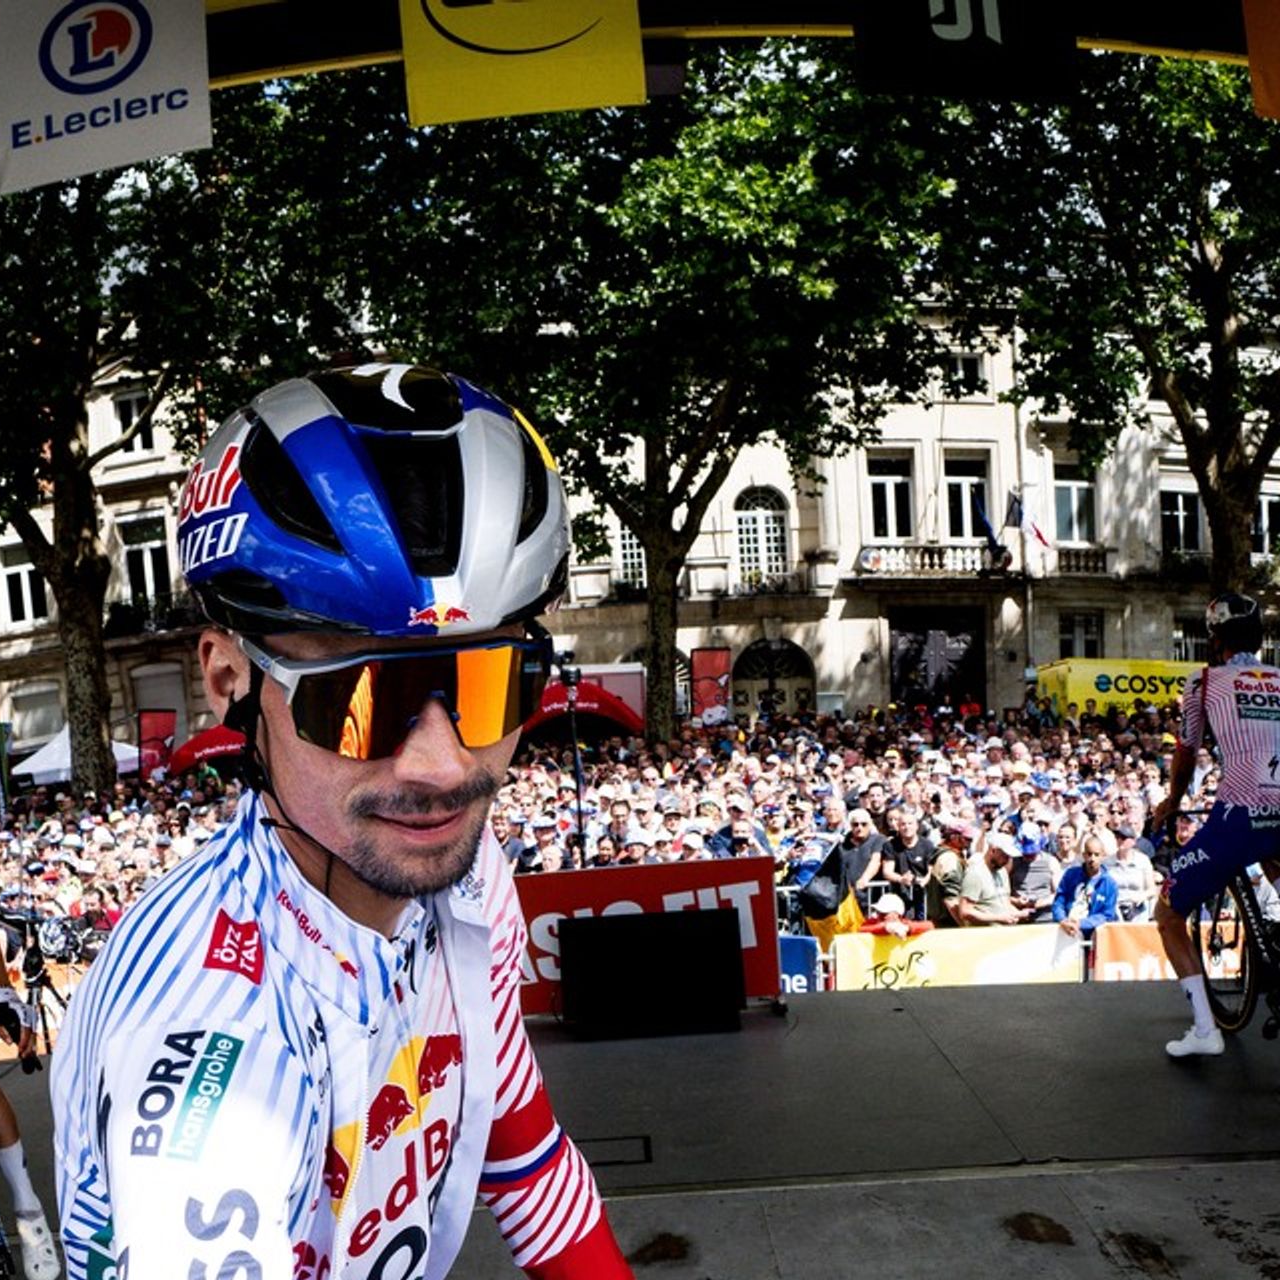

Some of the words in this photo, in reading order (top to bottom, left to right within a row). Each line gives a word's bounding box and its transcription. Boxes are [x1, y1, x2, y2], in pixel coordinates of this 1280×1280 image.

[11, 87, 189, 149] E.Leclerc
[1171, 847, 1210, 873] BORA
[238, 928, 262, 976] TAL
[130, 1028, 207, 1158] BORA
[165, 1037, 235, 1163] hansgrohe
